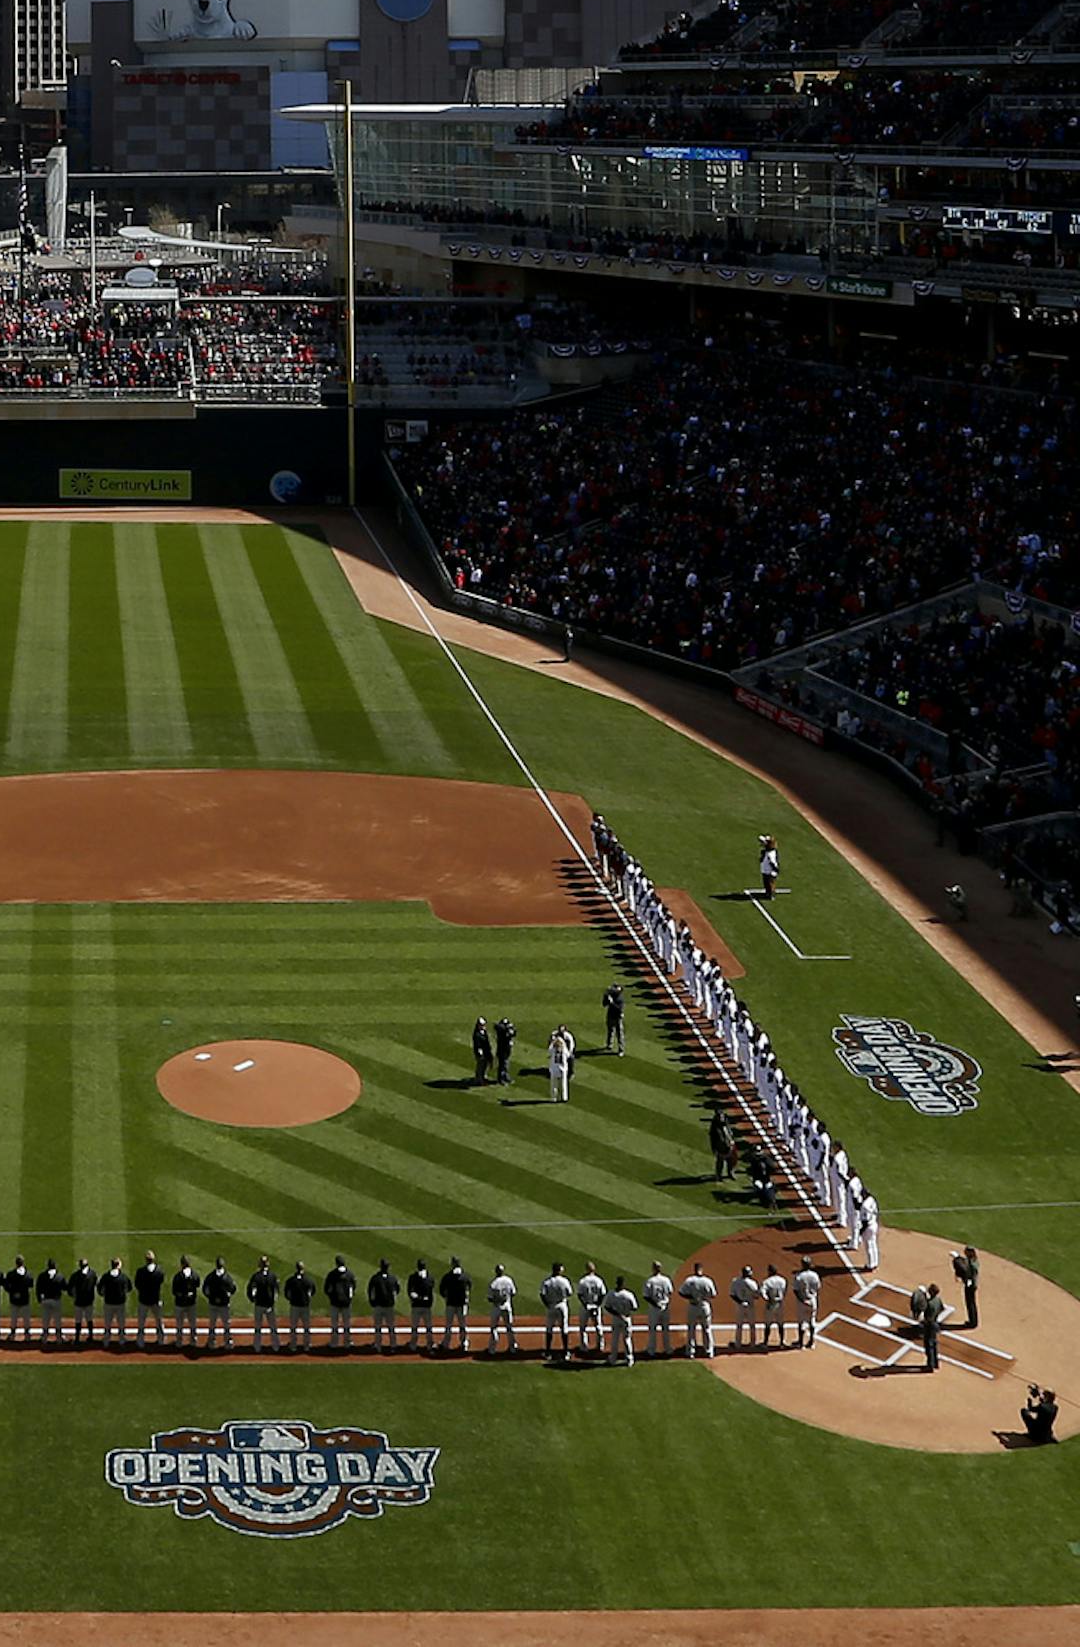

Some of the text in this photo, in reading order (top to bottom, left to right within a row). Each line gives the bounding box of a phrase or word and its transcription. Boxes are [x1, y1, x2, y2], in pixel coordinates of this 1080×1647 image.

[99, 478, 181, 493] CenturyLink
[844, 1015, 958, 1114] OPENING DAY
[112, 1452, 431, 1485] OPENING DAY
